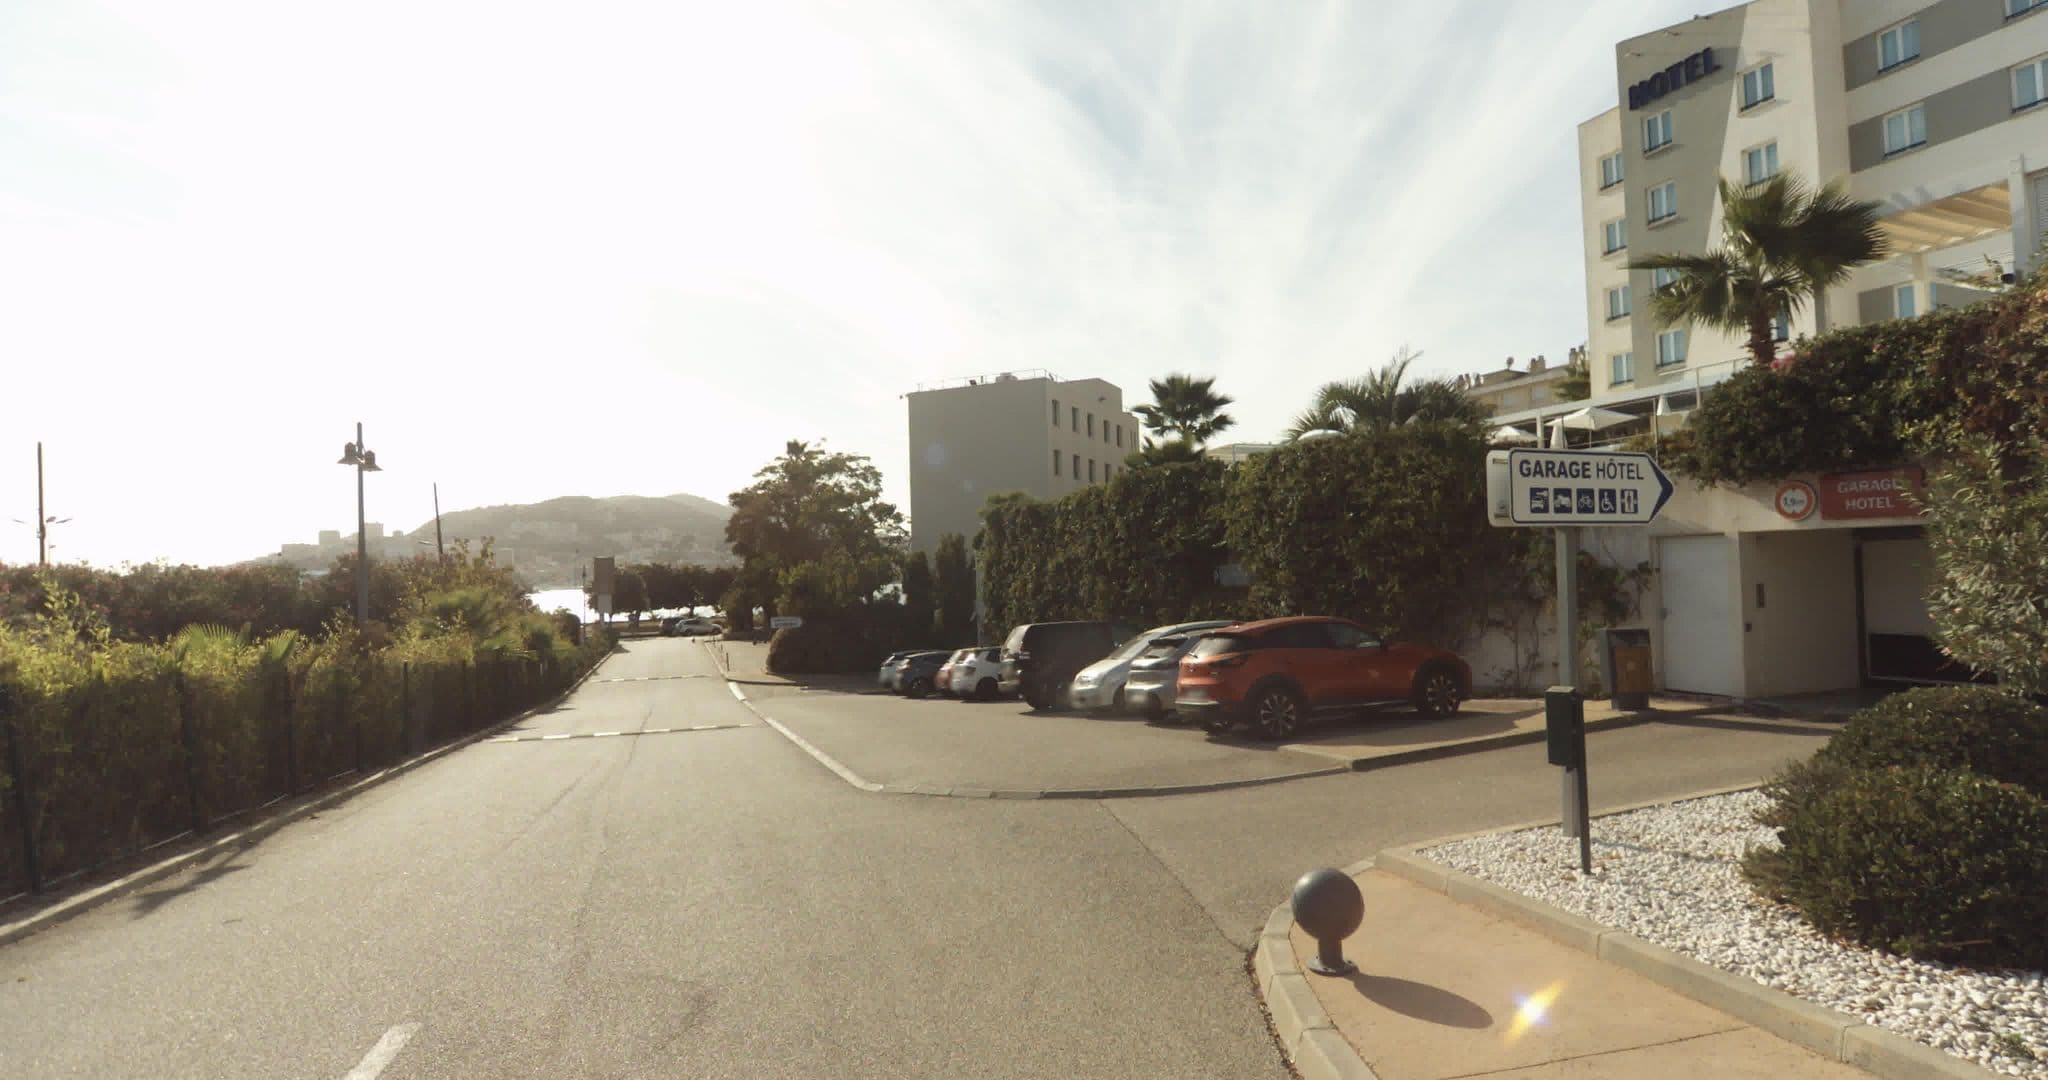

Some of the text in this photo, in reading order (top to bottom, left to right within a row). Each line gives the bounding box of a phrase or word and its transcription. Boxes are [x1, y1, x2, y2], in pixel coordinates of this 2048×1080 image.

[1520, 458, 1644, 480] GARAGE HÔTEL
[1837, 477, 1904, 494] GARAGE
[1845, 496, 1896, 511] HOTEL
